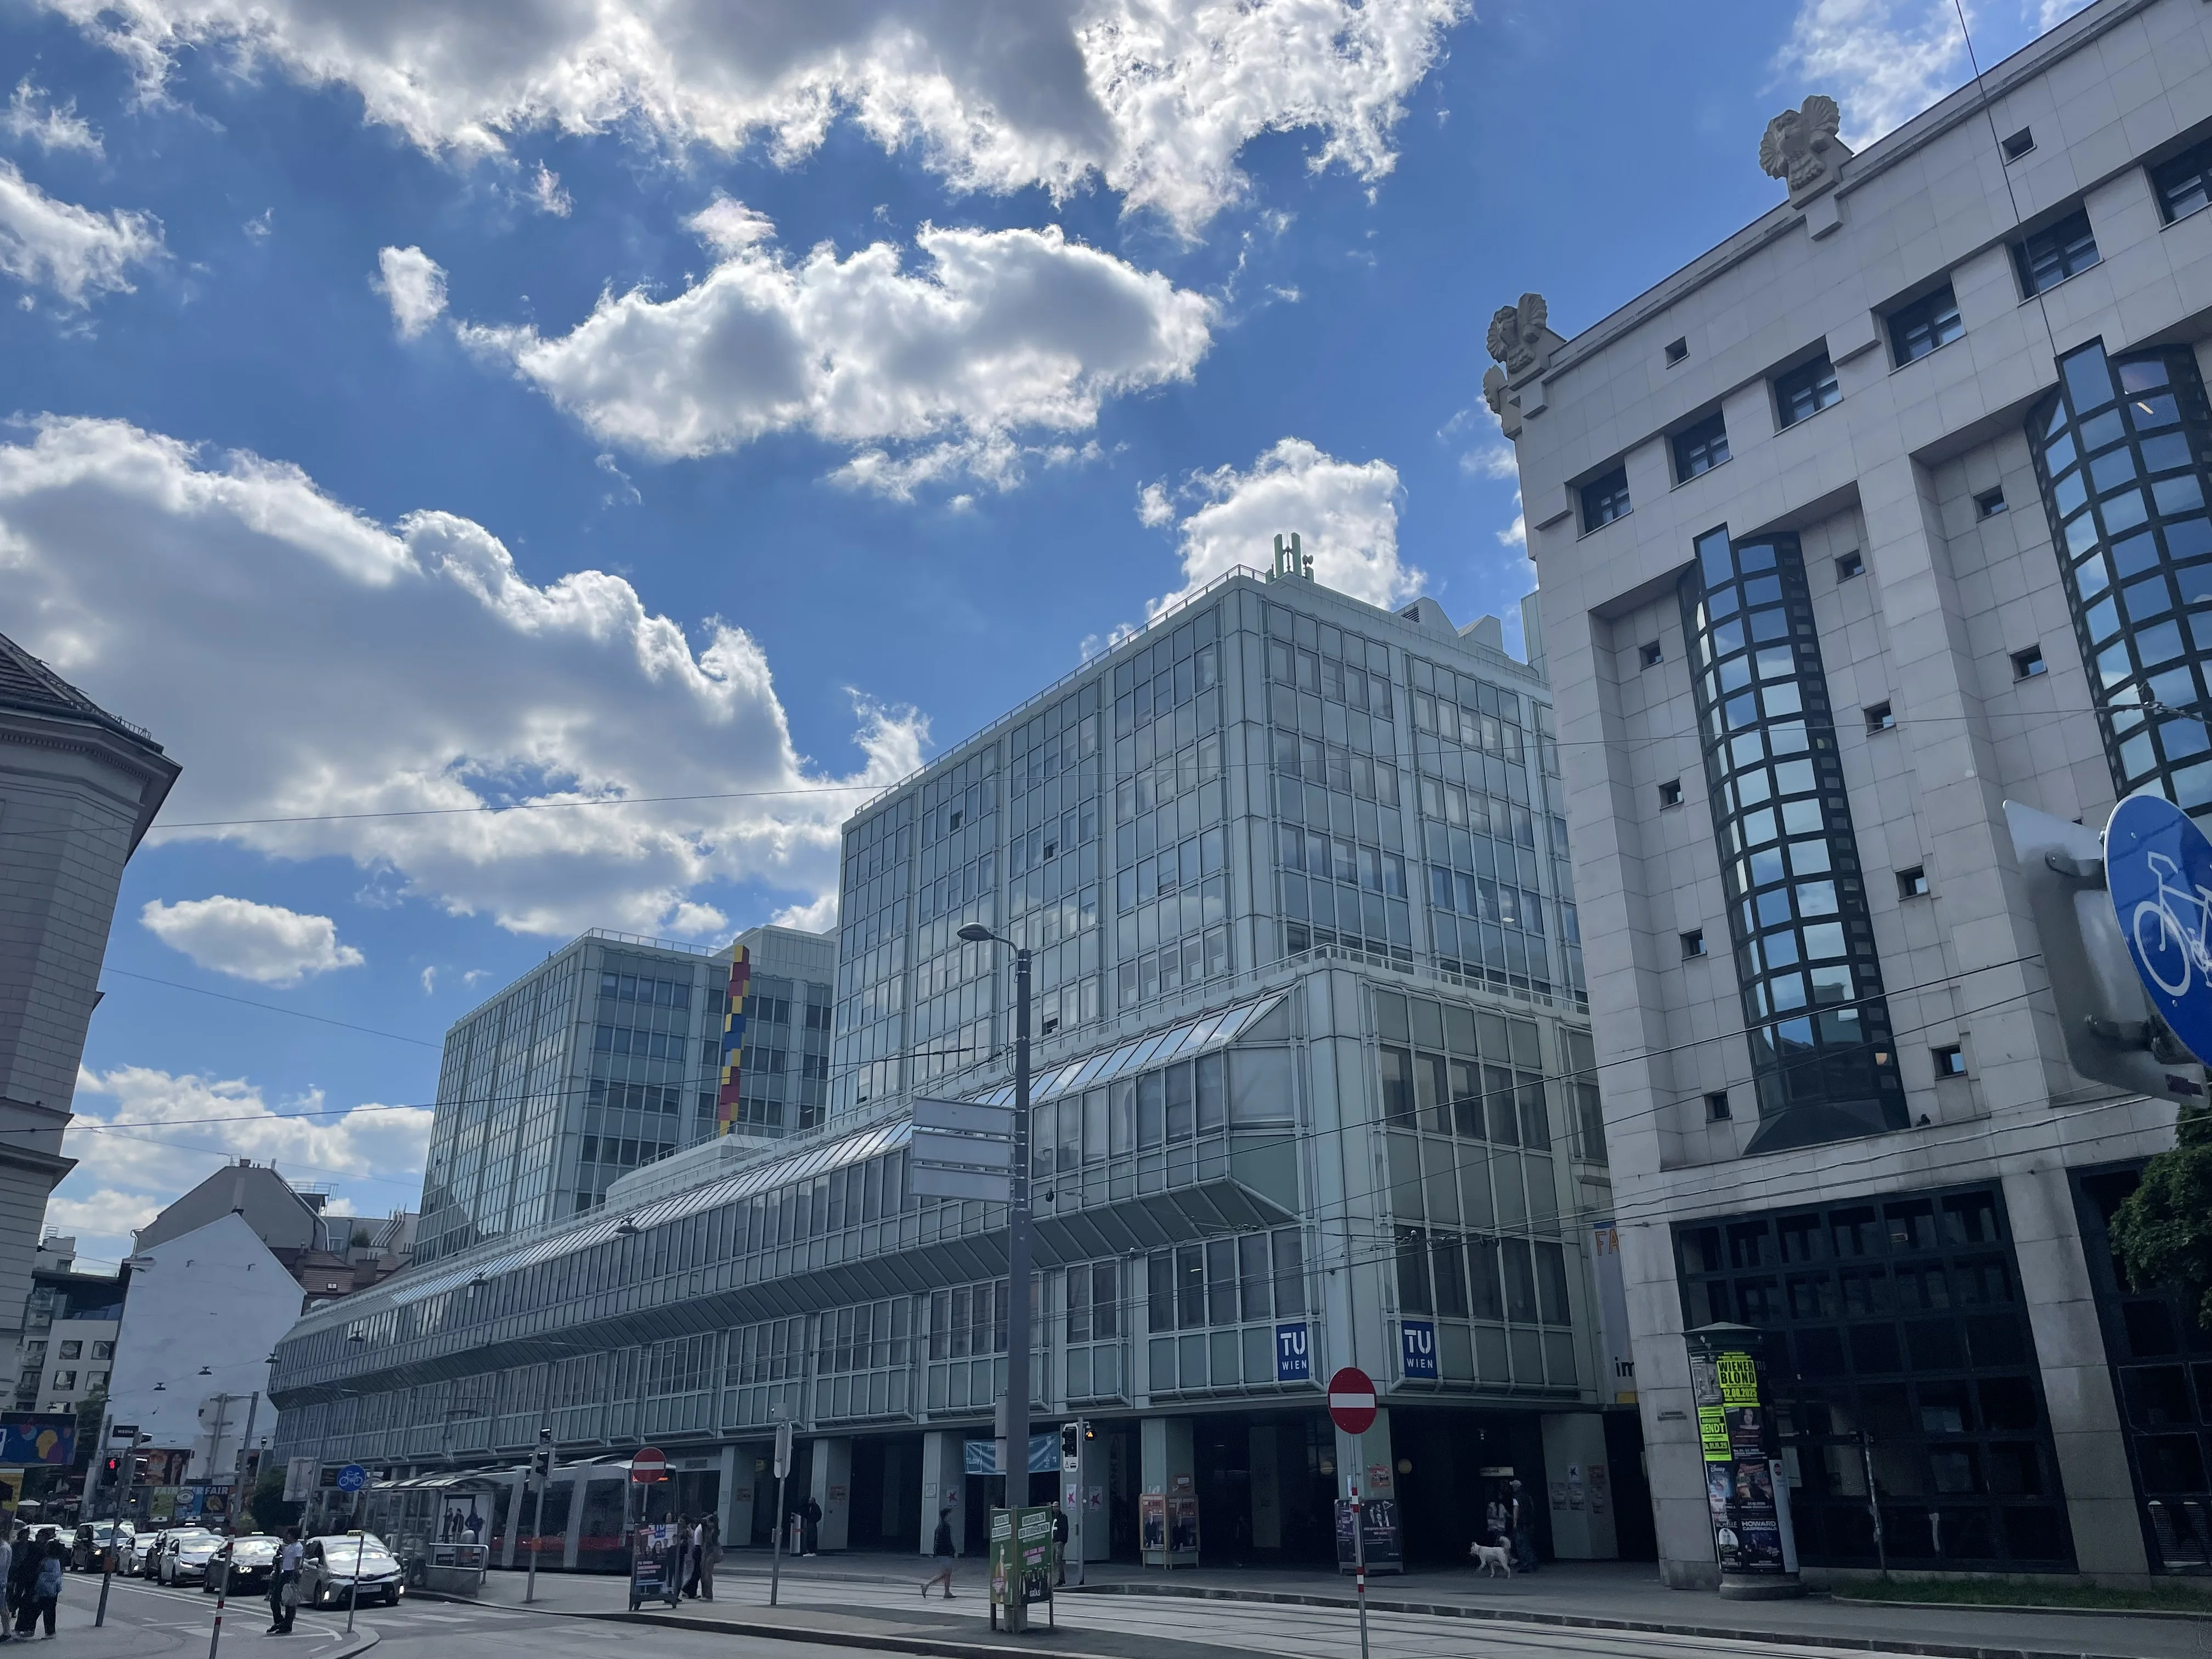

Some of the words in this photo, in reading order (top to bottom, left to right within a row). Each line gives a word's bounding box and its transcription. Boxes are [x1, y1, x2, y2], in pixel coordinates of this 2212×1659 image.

[1280, 1331, 1306, 1356] TU
[1404, 1329, 1430, 1354] TU
[1282, 1359, 1307, 1370] WIEN
[1407, 1358, 1433, 1369] WIEN
[1718, 1361, 1754, 1372] WIENER
[1720, 1372, 1755, 1384] BLOND
[205, 1487, 229, 1495] FAIR
